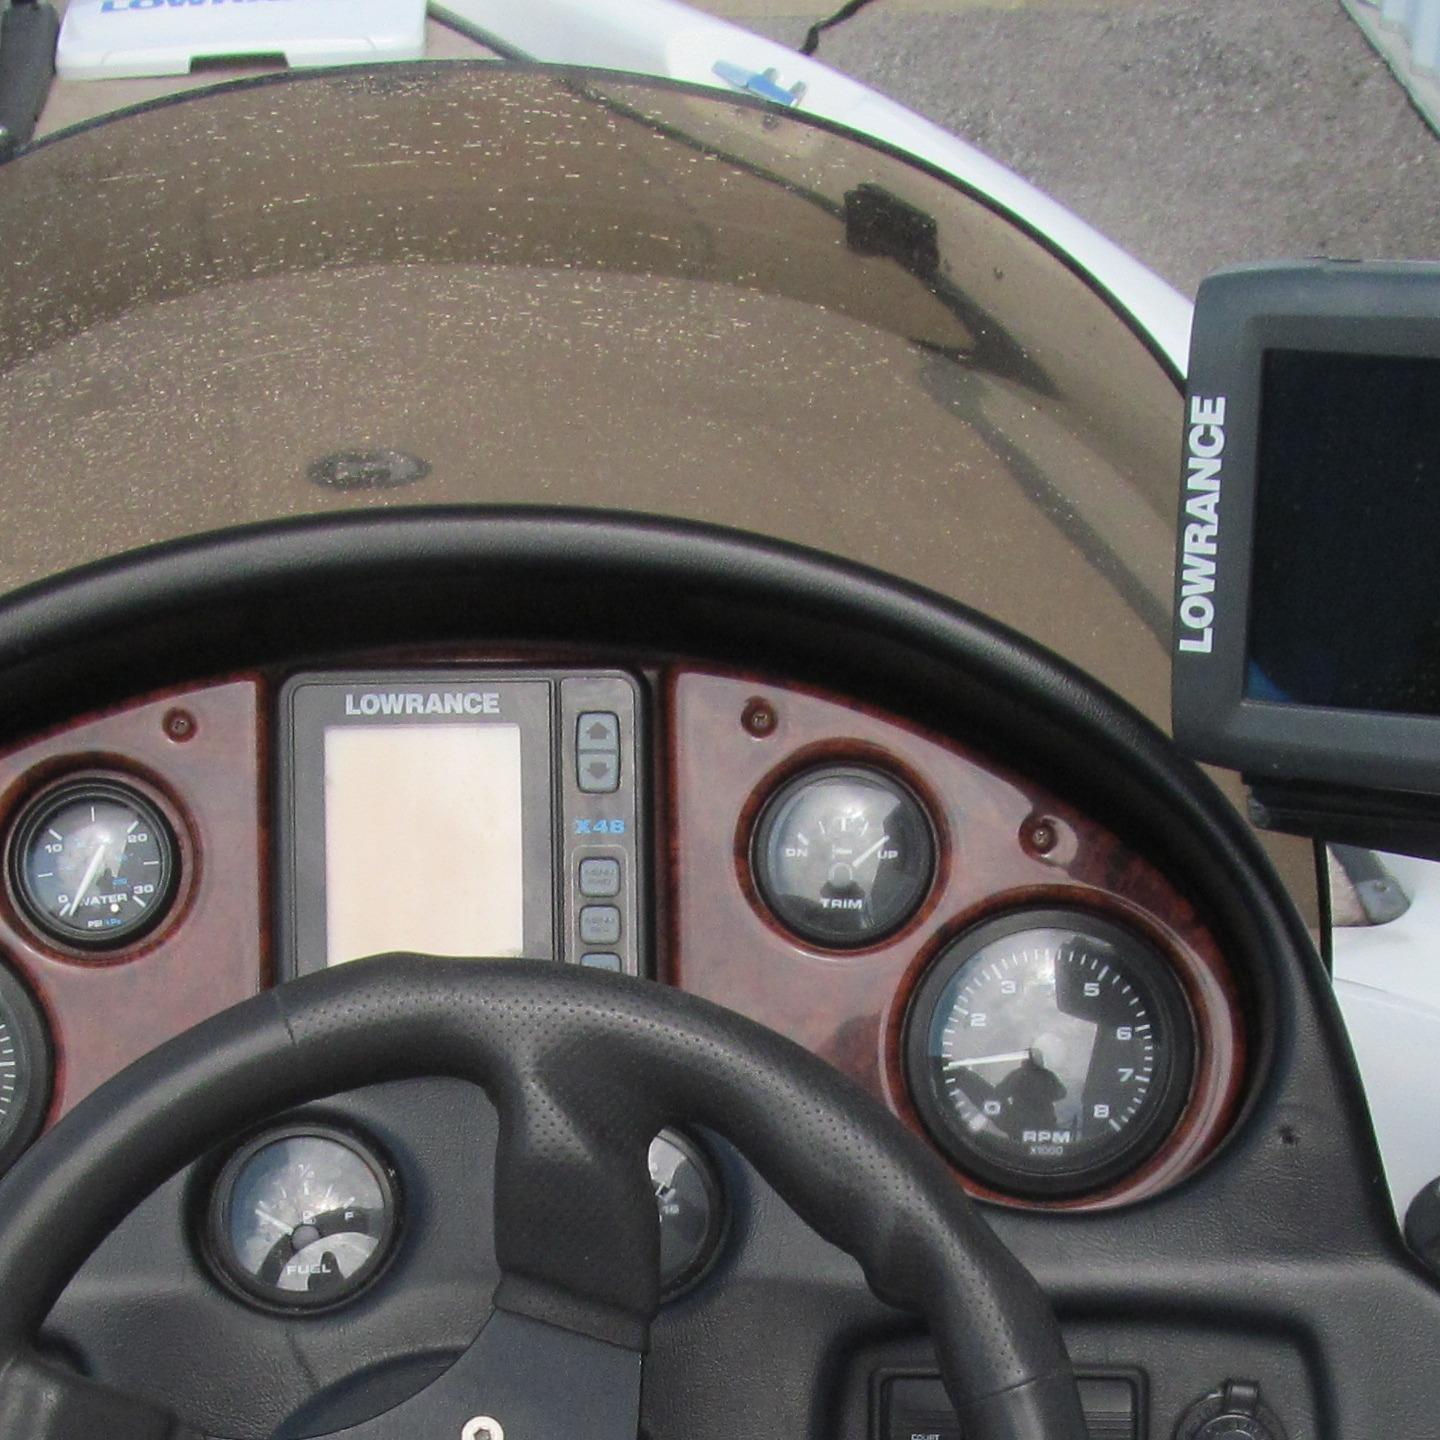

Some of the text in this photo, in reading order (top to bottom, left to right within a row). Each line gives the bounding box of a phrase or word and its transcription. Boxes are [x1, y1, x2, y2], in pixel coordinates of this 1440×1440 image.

[1178, 395, 1227, 654] LOWRANCE
[345, 692, 501, 715] LOWRANCE
[127, 833, 148, 844] 20
[44, 843, 62, 854] 10
[785, 848, 808, 858] DN
[877, 850, 899, 860] UP
[133, 884, 155, 895] 30
[820, 898, 863, 910] TRIM
[1000, 980, 1016, 994] 3
[1083, 982, 1100, 997] 5
[970, 1013, 987, 1027] 2
[1116, 1026, 1132, 1040] 6
[1117, 1067, 1134, 1082] 7
[984, 1101, 1001, 1115] 0
[1093, 1104, 1109, 1118] 8
[1023, 1130, 1071, 1143] RPM
[286, 1264, 332, 1275] FUEL
